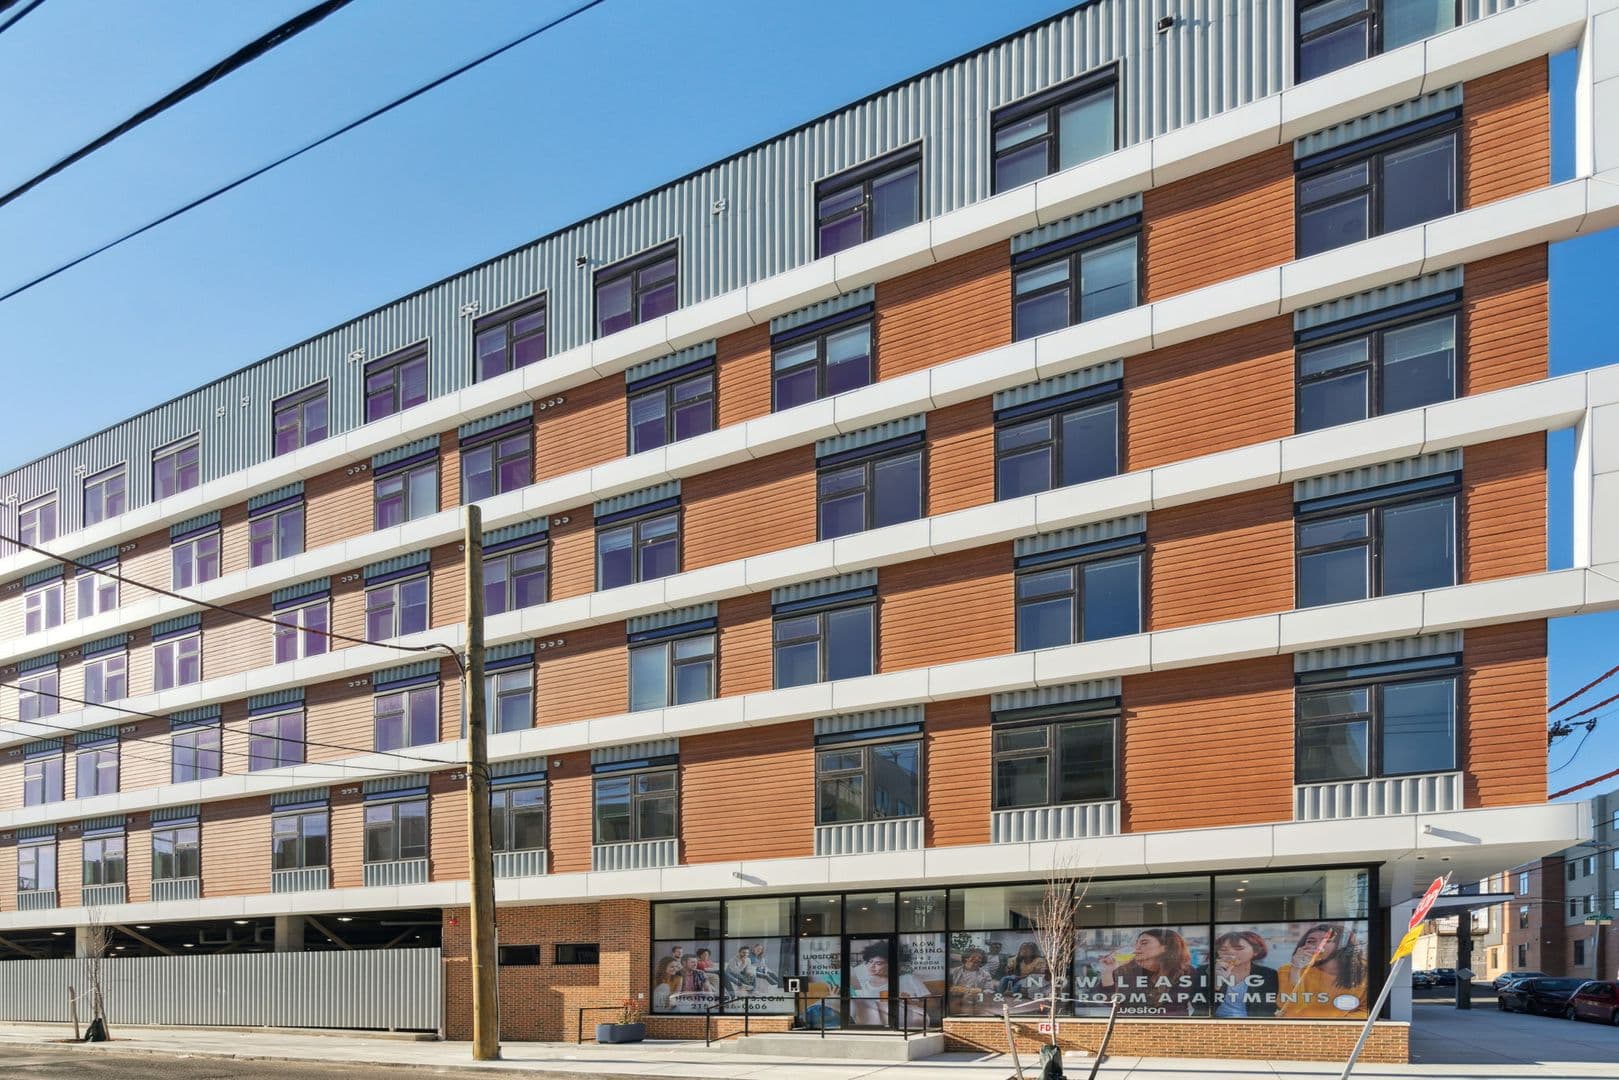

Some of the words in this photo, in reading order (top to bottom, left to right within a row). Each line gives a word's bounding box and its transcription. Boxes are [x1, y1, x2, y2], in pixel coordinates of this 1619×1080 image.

[1026, 975, 1097, 988] NOW
[1117, 974, 1264, 988] LEASING
[977, 993, 984, 1002] 1
[992, 993, 1005, 1002] &
[1013, 993, 1023, 1002] 2
[1158, 992, 1329, 1003] APARTMENTS
